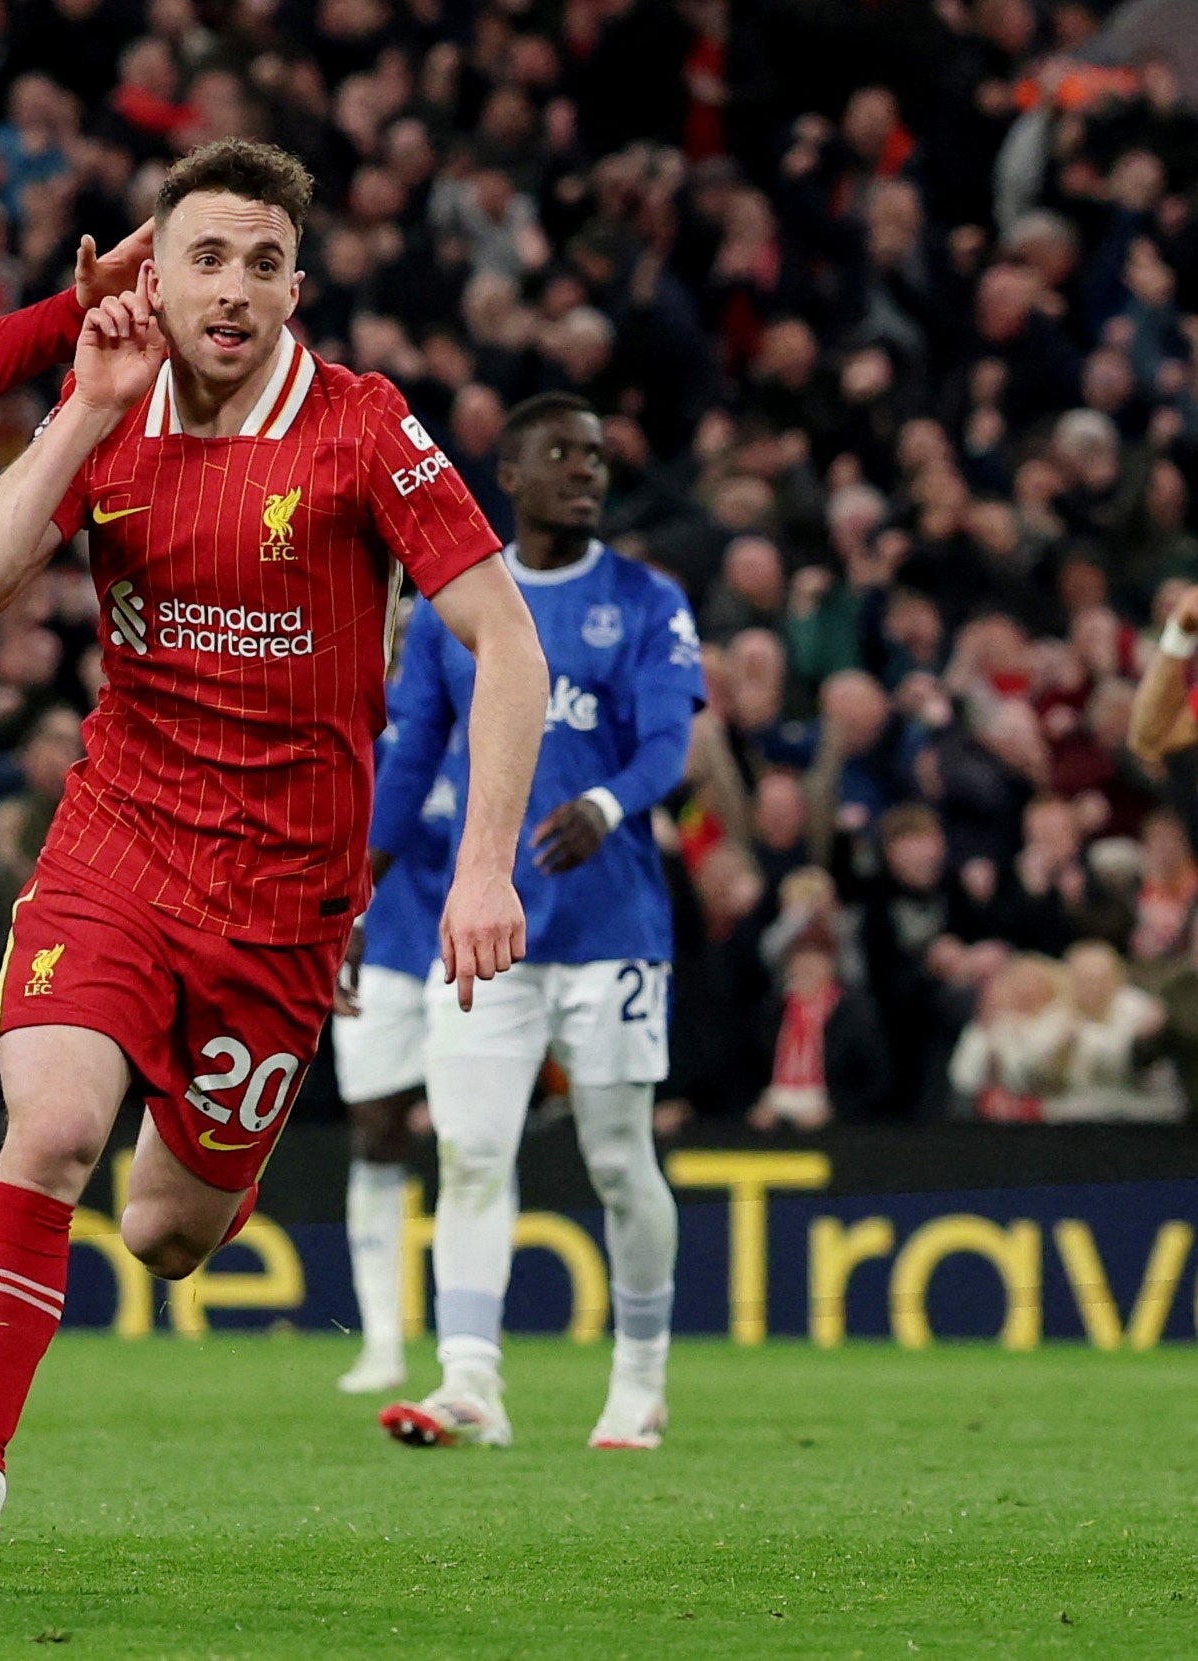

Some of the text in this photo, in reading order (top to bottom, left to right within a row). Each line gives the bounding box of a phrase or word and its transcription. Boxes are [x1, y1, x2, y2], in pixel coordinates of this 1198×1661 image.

[391, 450, 453, 496] Expe
[158, 598, 301, 633] standard
[159, 625, 313, 658] chartered
[545, 675, 599, 731] ke
[184, 1036, 300, 1132] 20
[666, 1149, 1198, 1352] Trav
